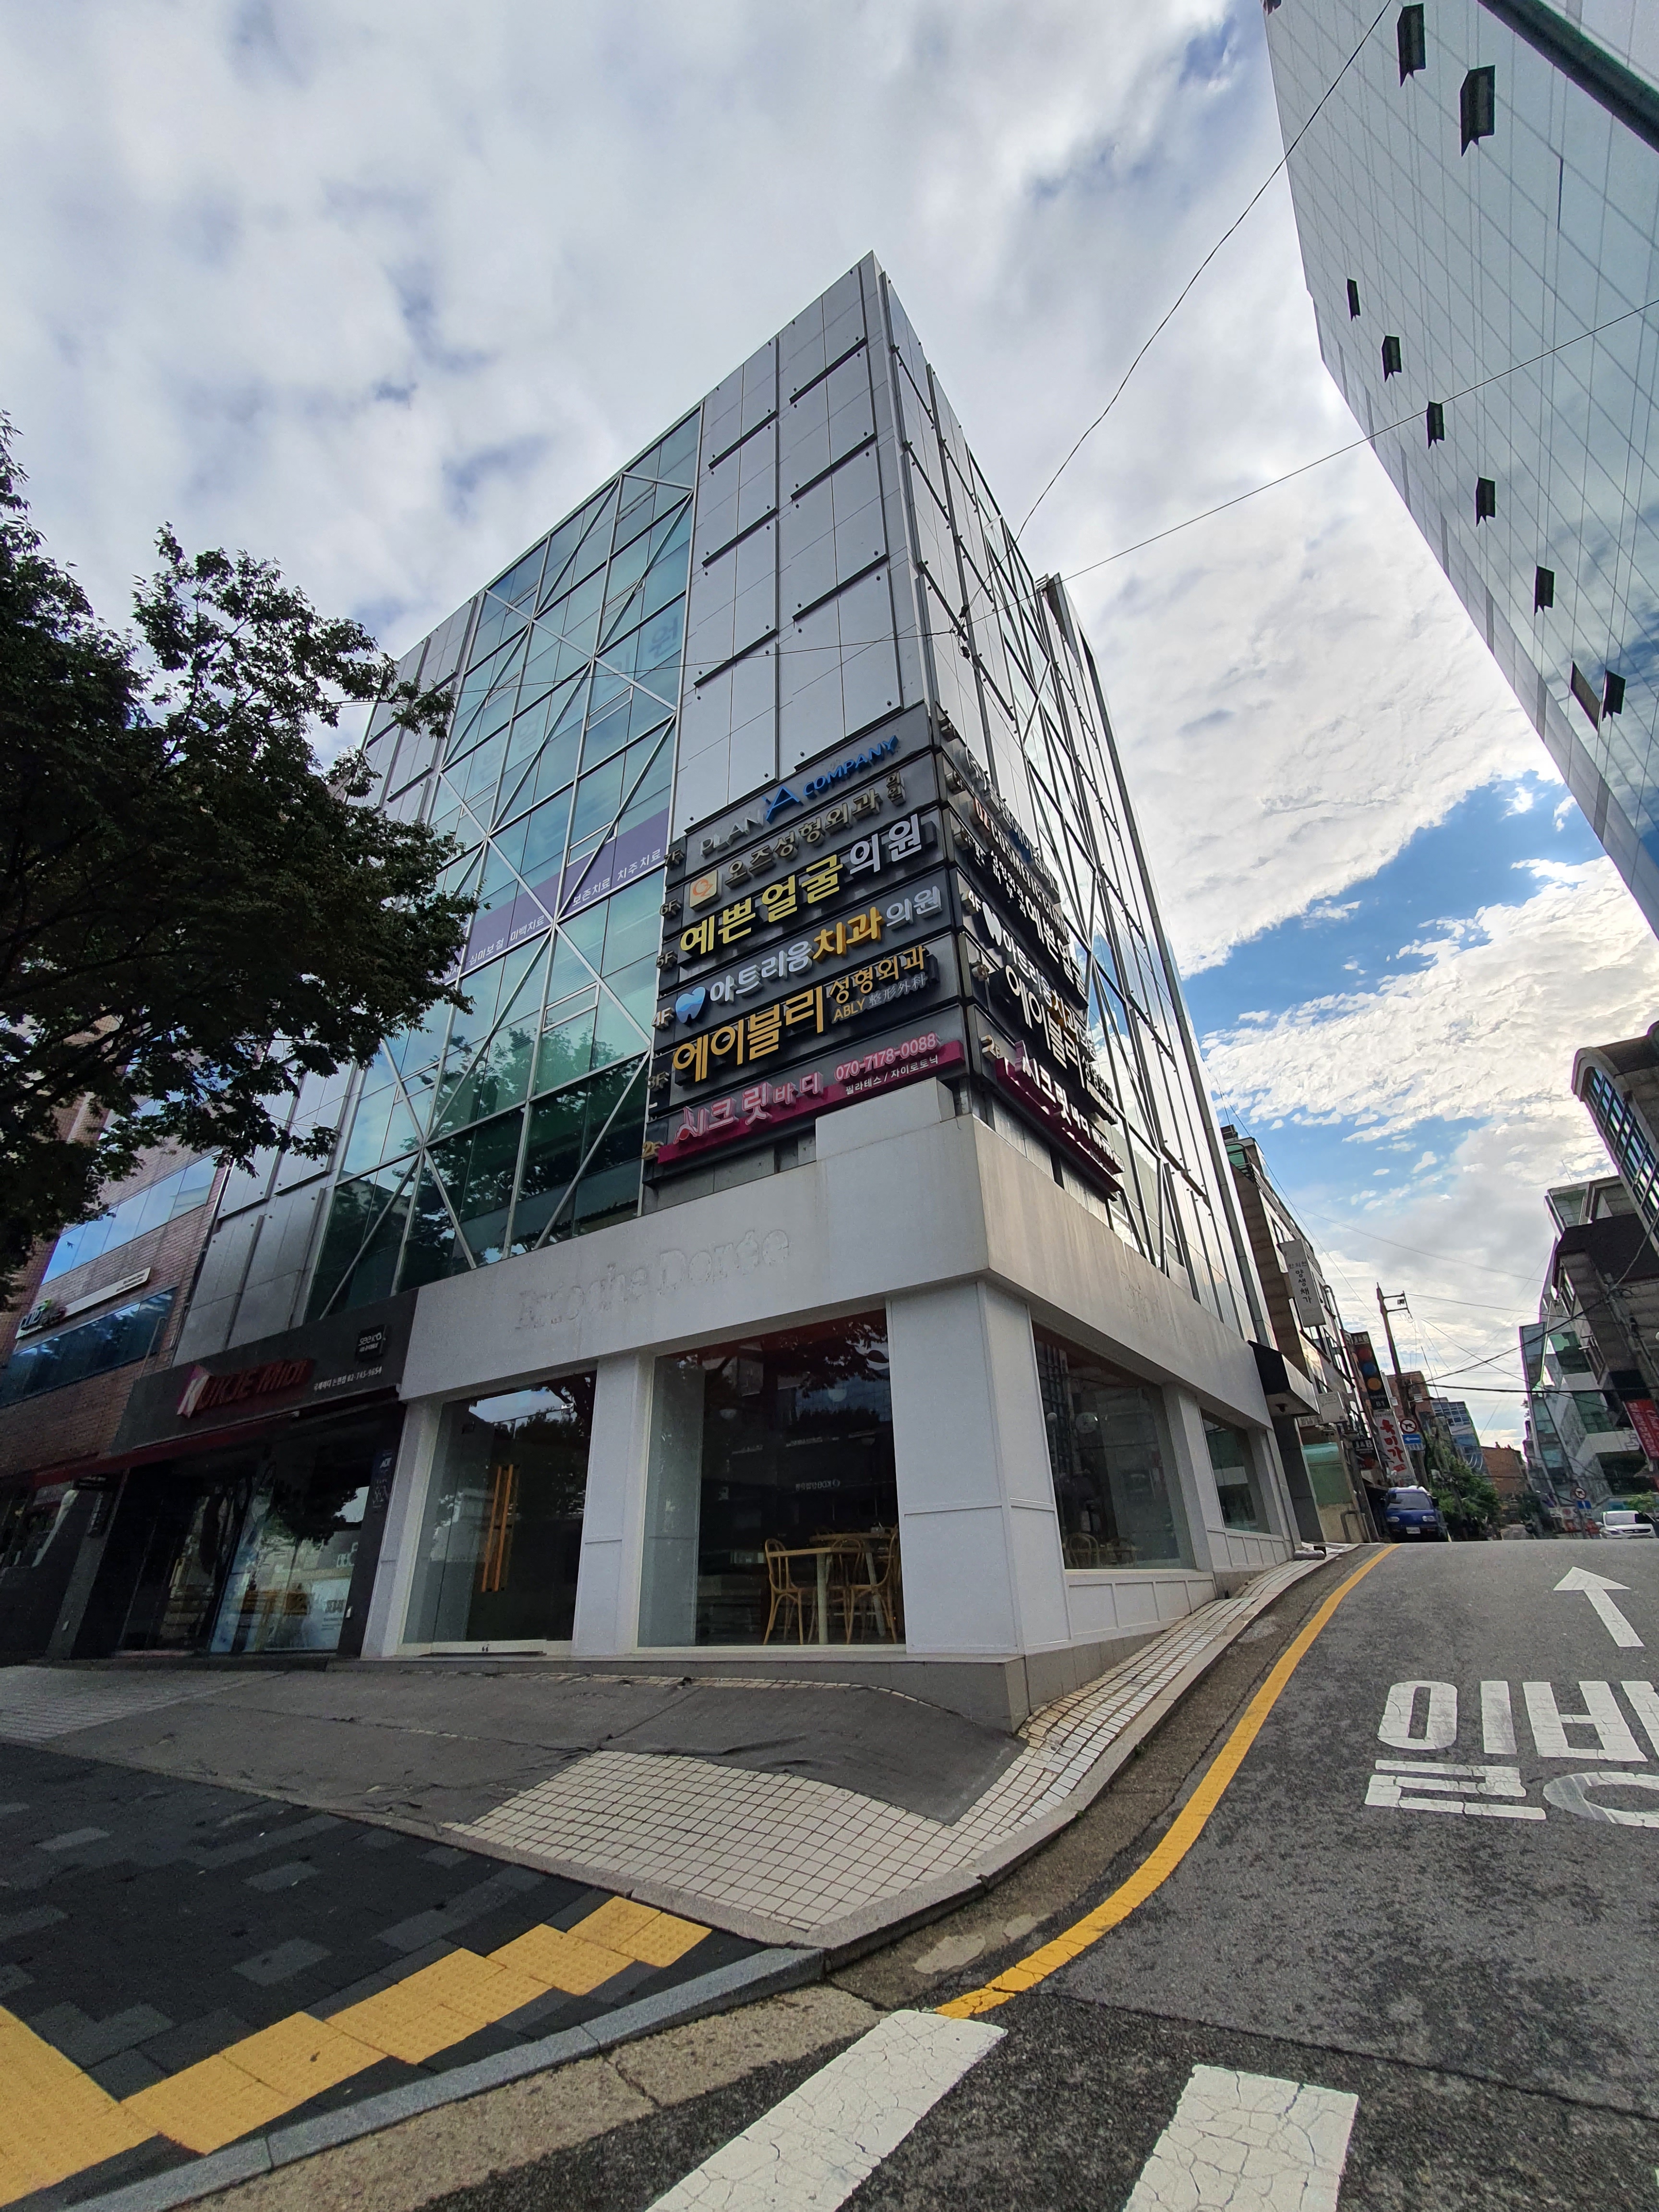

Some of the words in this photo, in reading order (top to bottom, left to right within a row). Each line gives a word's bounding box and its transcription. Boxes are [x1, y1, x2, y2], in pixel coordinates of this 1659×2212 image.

[699, 810, 764, 857] PLAN
[804, 735, 898, 795] COMPANY
[664, 848, 684, 865] 7F
[725, 789, 882, 884] 오즈성형외과
[680, 814, 921, 954] 예쁜얼굴의원
[968, 890, 982, 912] 4F
[991, 818, 1044, 901] COSMETIC
[1042, 892, 1070, 944] CLINIC
[469, 938, 504, 966] 심미보철
[510, 915, 544, 941] 미백치료
[572, 877, 611, 907] 보존치료
[617, 848, 661, 882] 치주치료
[660, 898, 681, 915] 6F
[656, 951, 677, 968] 5F
[652, 1007, 673, 1030] 4F
[673, 986, 823, 1082] 에이블리
[829, 945, 929, 1005] 성형외과
[832, 1001, 865, 1023] ABLY
[868, 972, 927, 1008] 整形外科
[1005, 964, 1085, 1088] 에이블리
[648, 1071, 670, 1091] 3F
[835, 1032, 938, 1082] 070-7178-0088
[846, 1076, 882, 1095] 필라테스
[891, 1055, 938, 1079] 자이로토닉
[642, 1141, 664, 1160] 2F
